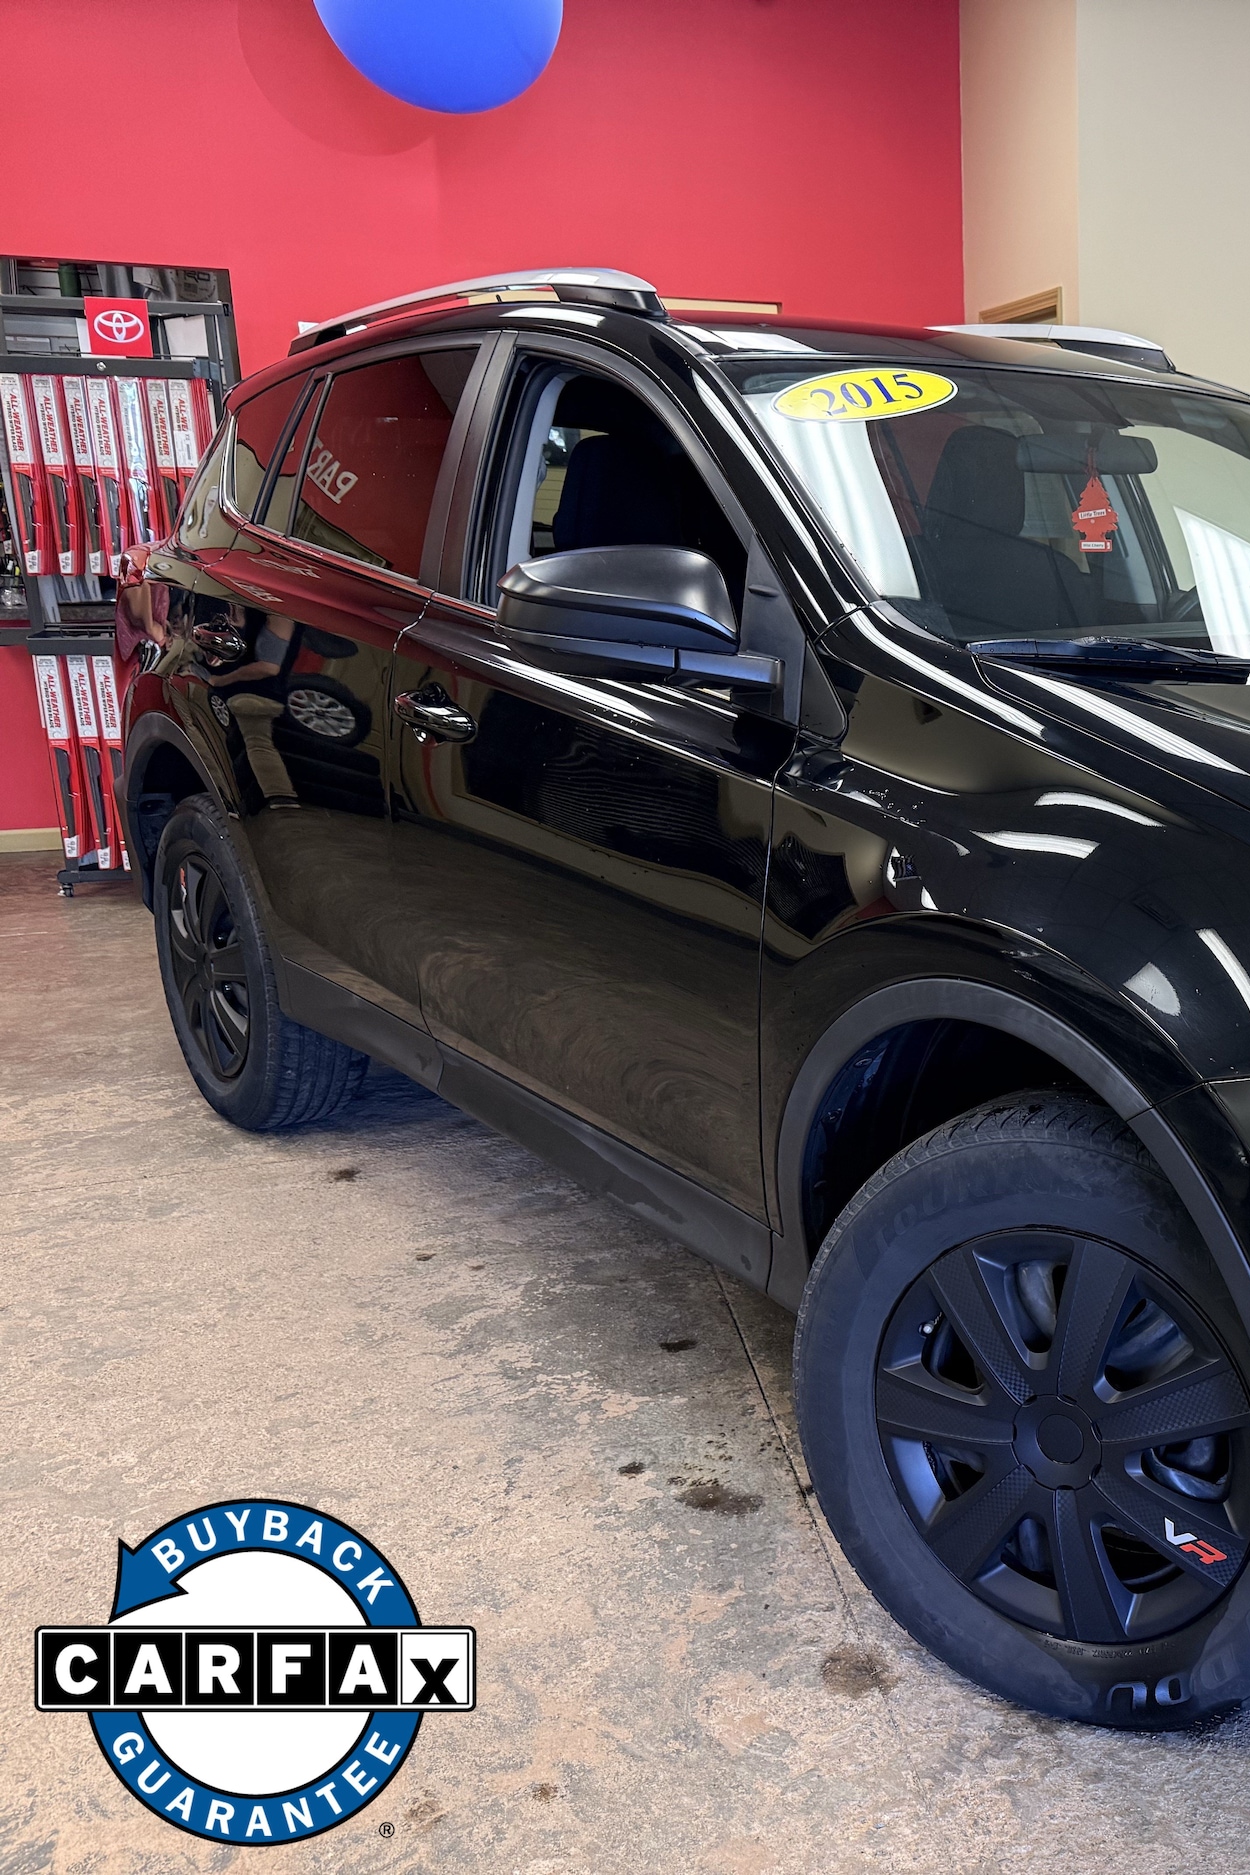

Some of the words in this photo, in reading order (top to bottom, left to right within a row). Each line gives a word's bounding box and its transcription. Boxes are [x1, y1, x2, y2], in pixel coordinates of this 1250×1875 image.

[10, 393, 24, 450] ALL-WEATHER
[810, 374, 924, 416] 2015
[43, 395, 58, 452] ALL-WEATHER
[73, 397, 87, 453] ALL-WEATHER
[98, 398, 111, 454] ALL-WEATHER
[156, 399, 169, 455] ALL-WEATHER
[46, 674, 61, 727] ALL-WEATHER
[77, 672, 91, 725] ALL-WEATHER
[103, 674, 116, 727] ALL-WEATHER
[1164, 1516, 1228, 1565] VR
